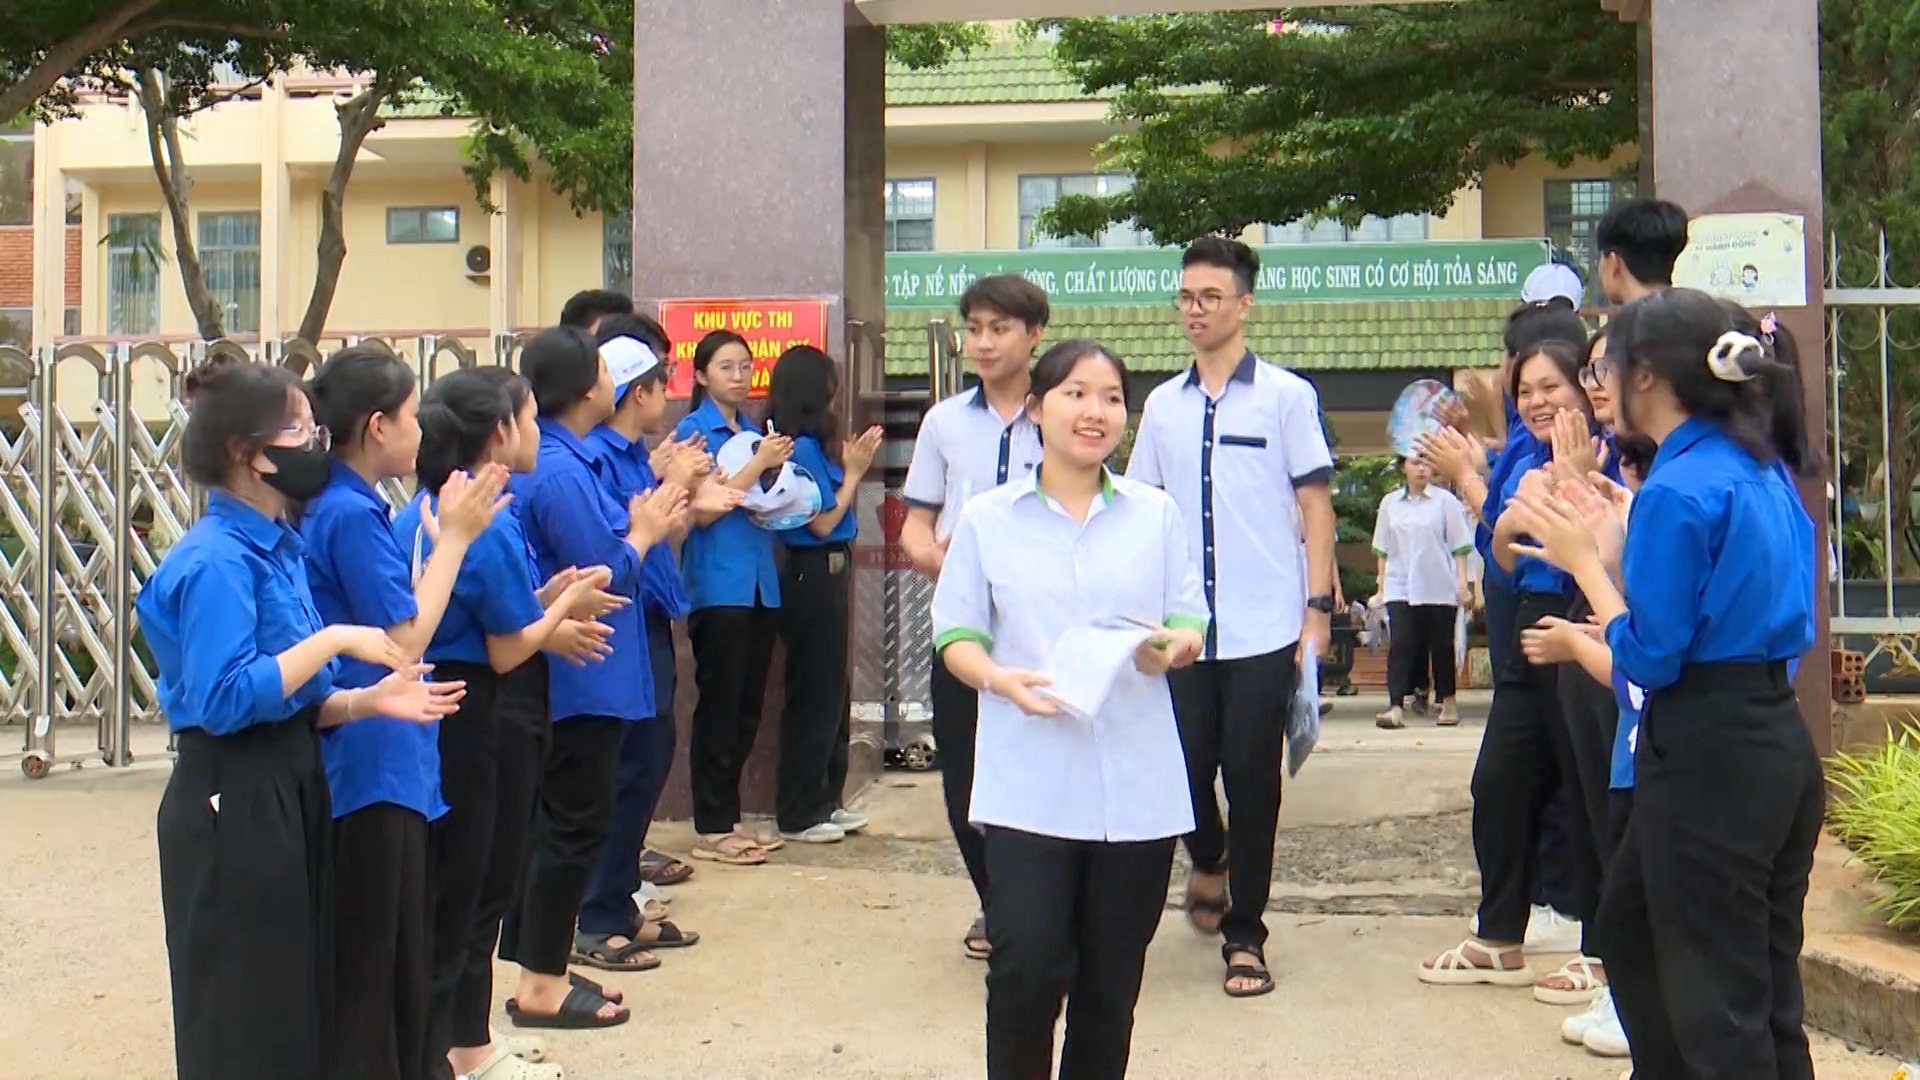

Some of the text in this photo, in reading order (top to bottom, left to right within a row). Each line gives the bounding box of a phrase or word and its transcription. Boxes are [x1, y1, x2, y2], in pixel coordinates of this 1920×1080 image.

[892, 269, 920, 300] TẬP
[1064, 261, 1106, 294] CHẤT
[1110, 265, 1157, 297] LƯỢNG
[1290, 265, 1322, 294] HỌC
[1326, 264, 1361, 289] SINH
[1365, 257, 1384, 288] CÓ
[1389, 260, 1410, 288] CƠ
[1413, 258, 1440, 292] HỘI
[1443, 253, 1474, 287] TỎA
[1477, 255, 1518, 286] SÁNG
[693, 308, 793, 332] KHU VỰC THI
[749, 337, 781, 362] HẬN
[752, 368, 771, 387] VÀ
